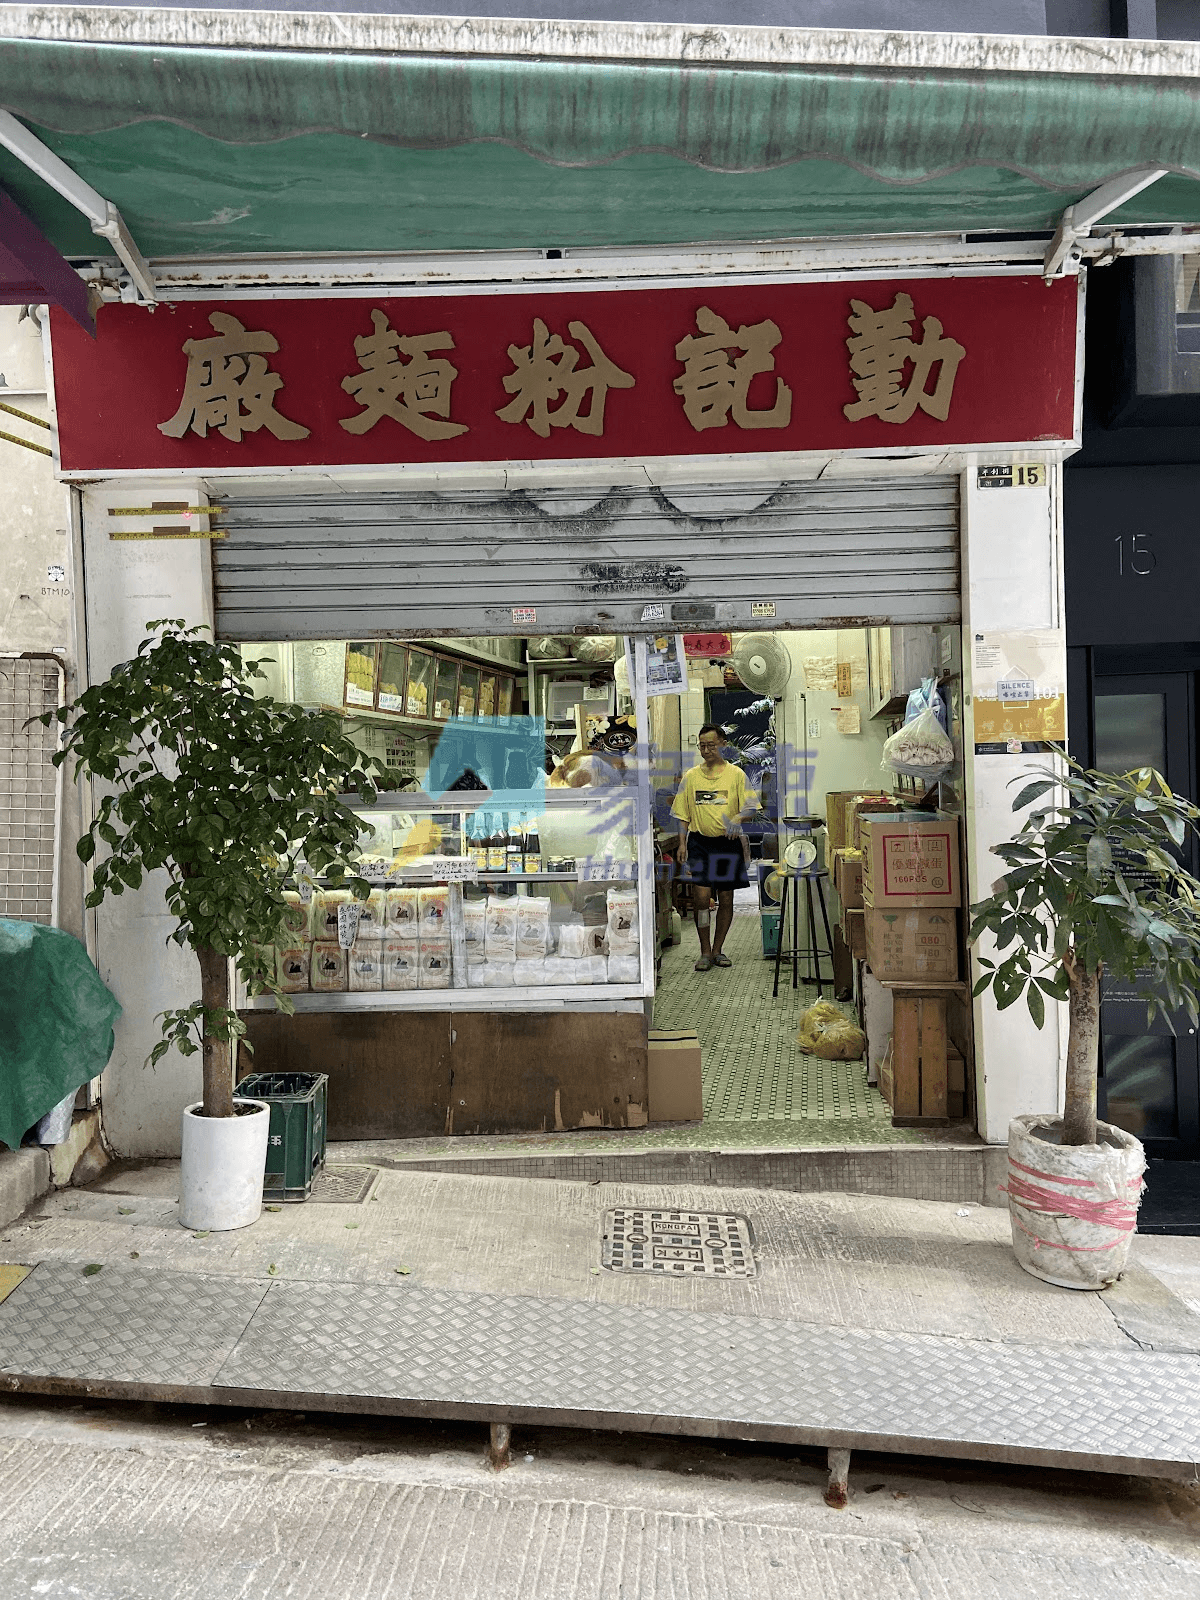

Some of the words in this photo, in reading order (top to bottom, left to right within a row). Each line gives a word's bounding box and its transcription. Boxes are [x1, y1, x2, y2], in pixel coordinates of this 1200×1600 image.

[157, 291, 966, 443] 勤記粉麵廠
[1017, 467, 1039, 485] 15
[1114, 533, 1157, 576] 15
[1001, 682, 1031, 690] SILENCE
[894, 875, 928, 884] 160PCS
